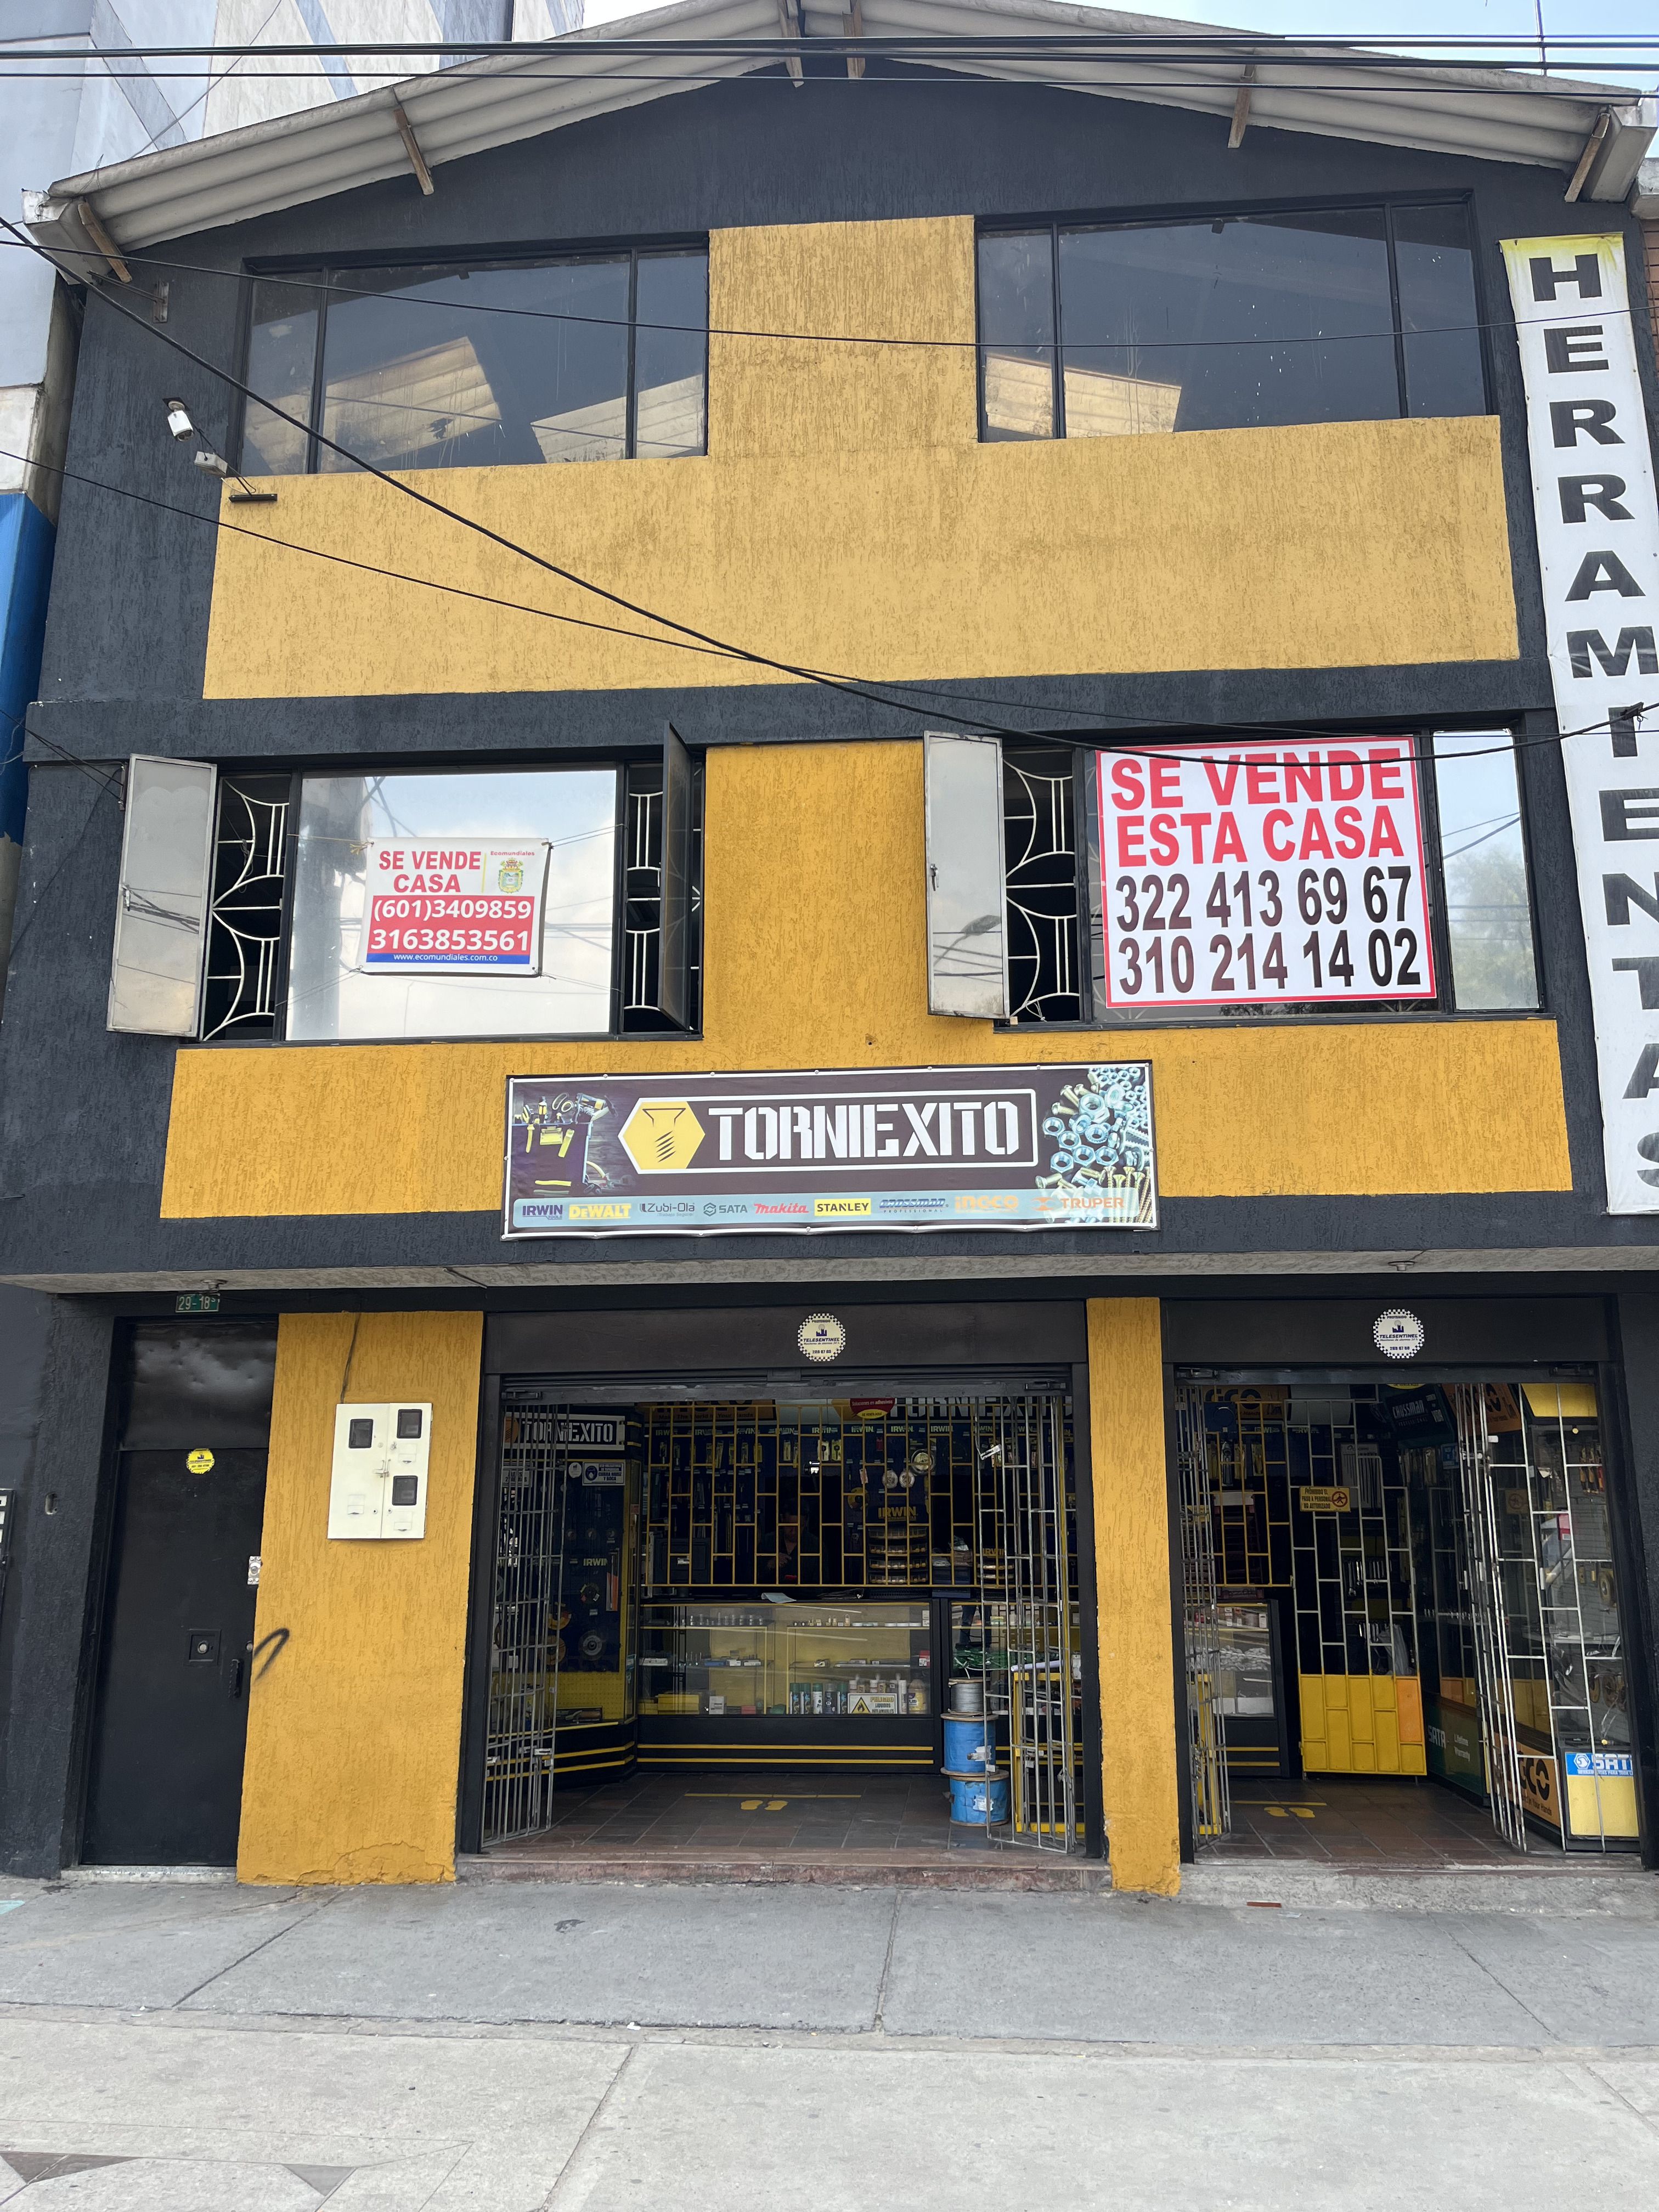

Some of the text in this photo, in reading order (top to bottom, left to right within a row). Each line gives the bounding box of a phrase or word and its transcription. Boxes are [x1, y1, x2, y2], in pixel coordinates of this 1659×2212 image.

[1110, 748, 1405, 811] SE VENDE
[1116, 805, 1404, 867] ESTA CASA
[379, 851, 481, 870] SE VENDE
[393, 874, 461, 893] CASA
[1115, 865, 1411, 933] 322 413 69 67
[374, 900, 531, 921] (601)3409859
[370, 929, 528, 951] 3163853561
[393, 953, 498, 962] www.ecomundiales.com.co
[1119, 928, 1420, 995] 310 214 14 02
[708, 1102, 1019, 1161] TORNIEXITO
[522, 1205, 563, 1216] IRWIN
[648, 1203, 695, 1212] Zubi-Ola
[719, 1204, 748, 1214] SATA
[817, 1203, 869, 1212] STANLEY
[1059, 1197, 1125, 1209] TRUPER
[1427, 1725, 1446, 1749] SATA
